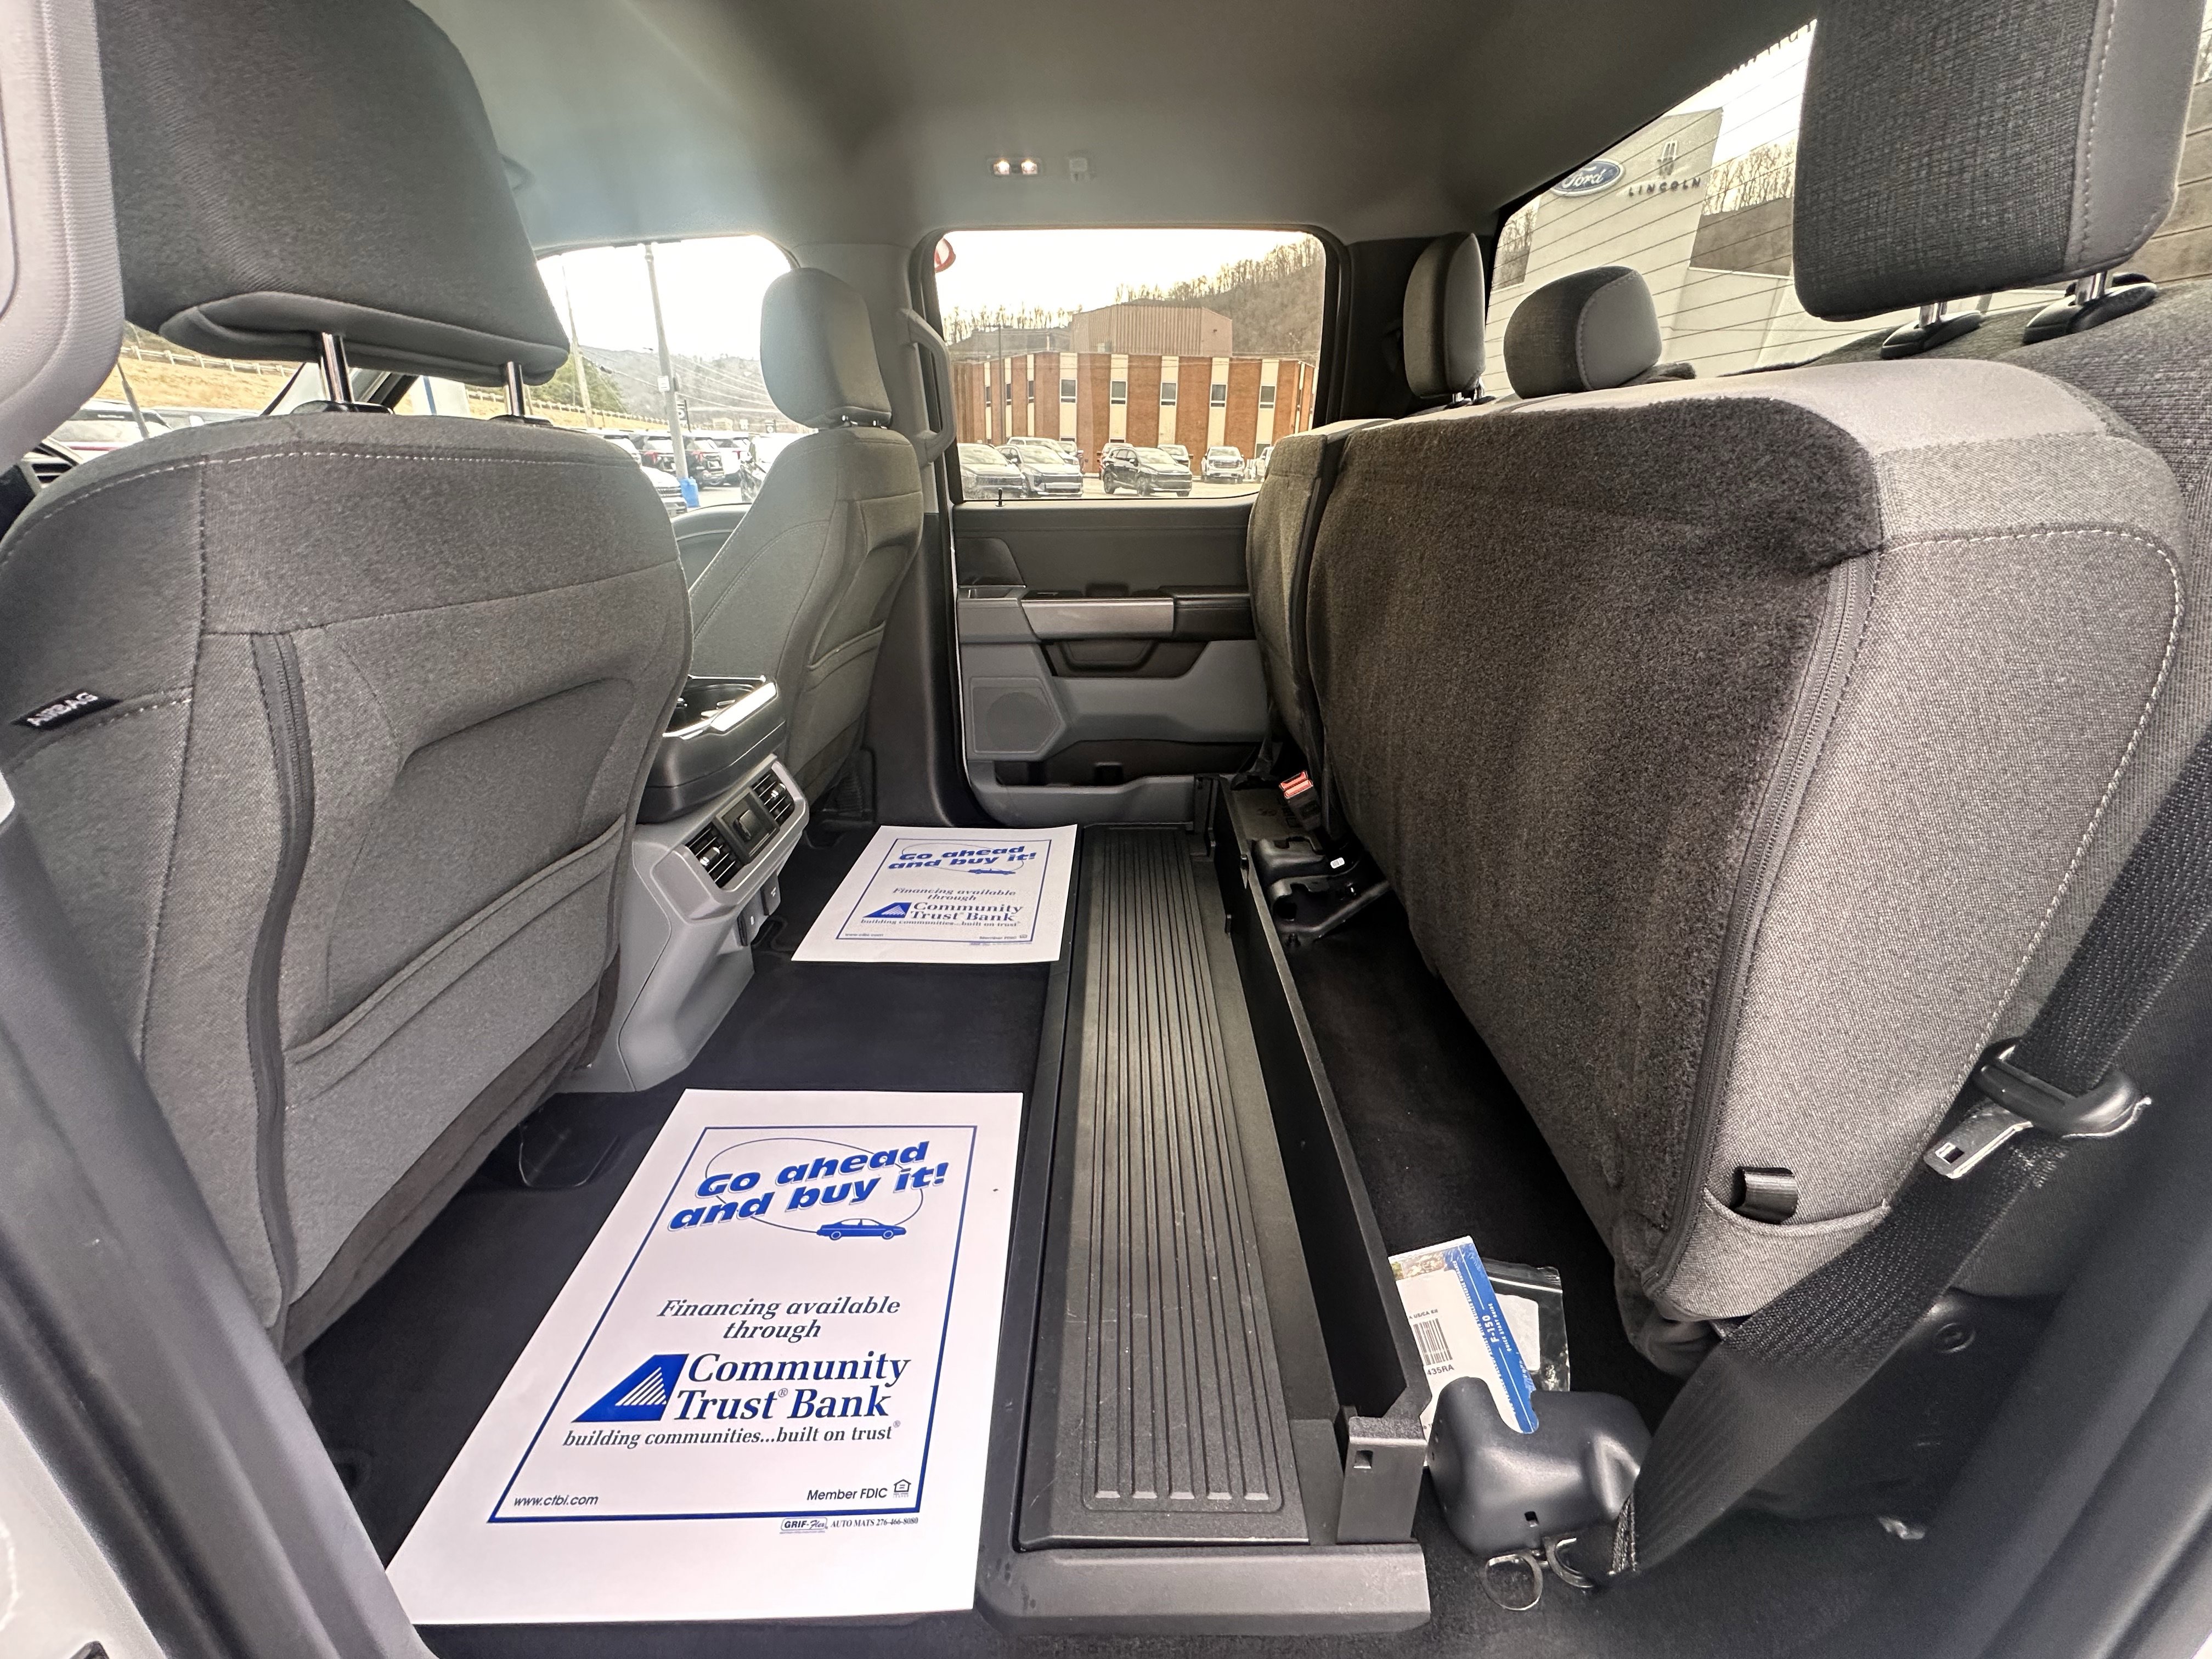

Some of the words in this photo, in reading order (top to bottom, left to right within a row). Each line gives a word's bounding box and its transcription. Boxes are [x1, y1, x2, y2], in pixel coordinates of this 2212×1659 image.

[1563, 166, 1606, 188] Ford
[1629, 177, 1701, 196] LINCOLN
[888, 860, 941, 869] and
[949, 857, 1000, 866] buy
[1007, 852, 1036, 861] it!
[941, 846, 1025, 858] ahead
[913, 902, 1023, 914] Community
[967, 912, 1015, 921] Bank
[696, 1172, 761, 1198] Go
[775, 1141, 930, 1186] ahead
[667, 1192, 775, 1231] and
[785, 1177, 881, 1212] buy
[893, 1162, 949, 1193] it!
[657, 1298, 782, 1319] Financing
[786, 1296, 901, 1315] available
[723, 1319, 822, 1343] through
[1481, 1315, 1499, 1343] F-150
[689, 1350, 911, 1387] Community
[1426, 1364, 1455, 1376] 435RA
[787, 1385, 891, 1419] Bank
[562, 1430, 641, 1449] building
[823, 1430, 845, 1442] on
[514, 1494, 599, 1506] www.ctbi.com
[806, 1489, 857, 1500] Member
[860, 1487, 888, 1499] FDIC
[831, 1519, 853, 1527] AUTO
[854, 1519, 875, 1527] MATS
[876, 1516, 919, 1526] 276-466-8080
